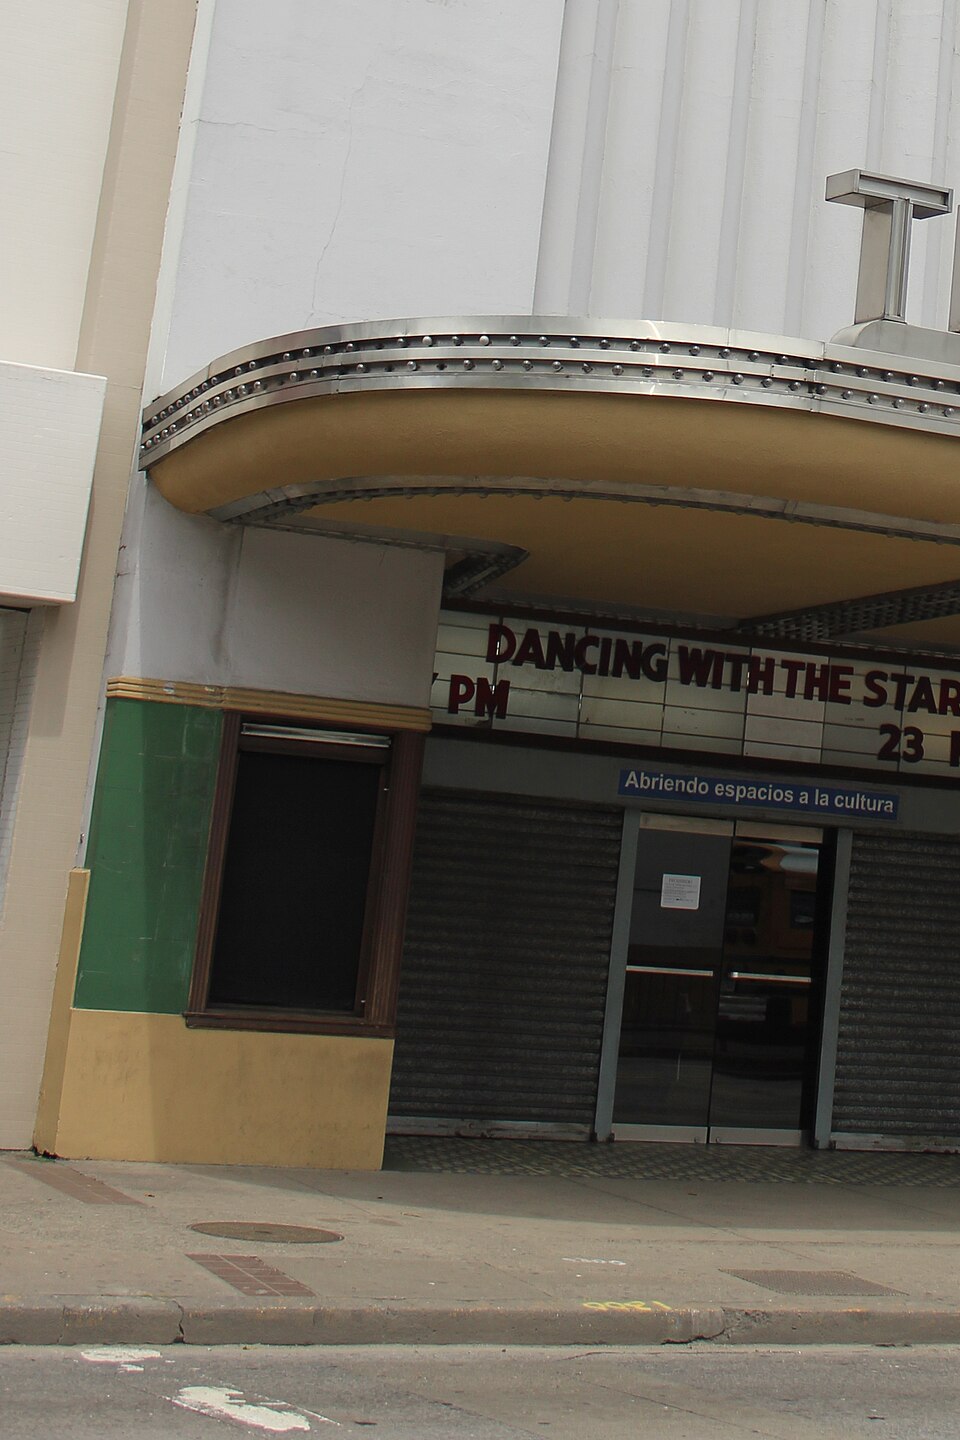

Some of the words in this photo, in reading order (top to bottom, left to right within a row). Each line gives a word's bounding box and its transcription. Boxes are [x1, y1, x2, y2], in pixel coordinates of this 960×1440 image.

[486, 623, 668, 682] DANCING
[677, 645, 775, 696] WITH
[781, 659, 854, 705] THE
[448, 674, 510, 719] PM
[877, 724, 924, 763] 23
[625, 770, 709, 795] Abriendo
[714, 782, 794, 803] espacios
[799, 791, 808, 804] a
[815, 789, 829, 806] la
[834, 793, 894, 813] cultura
